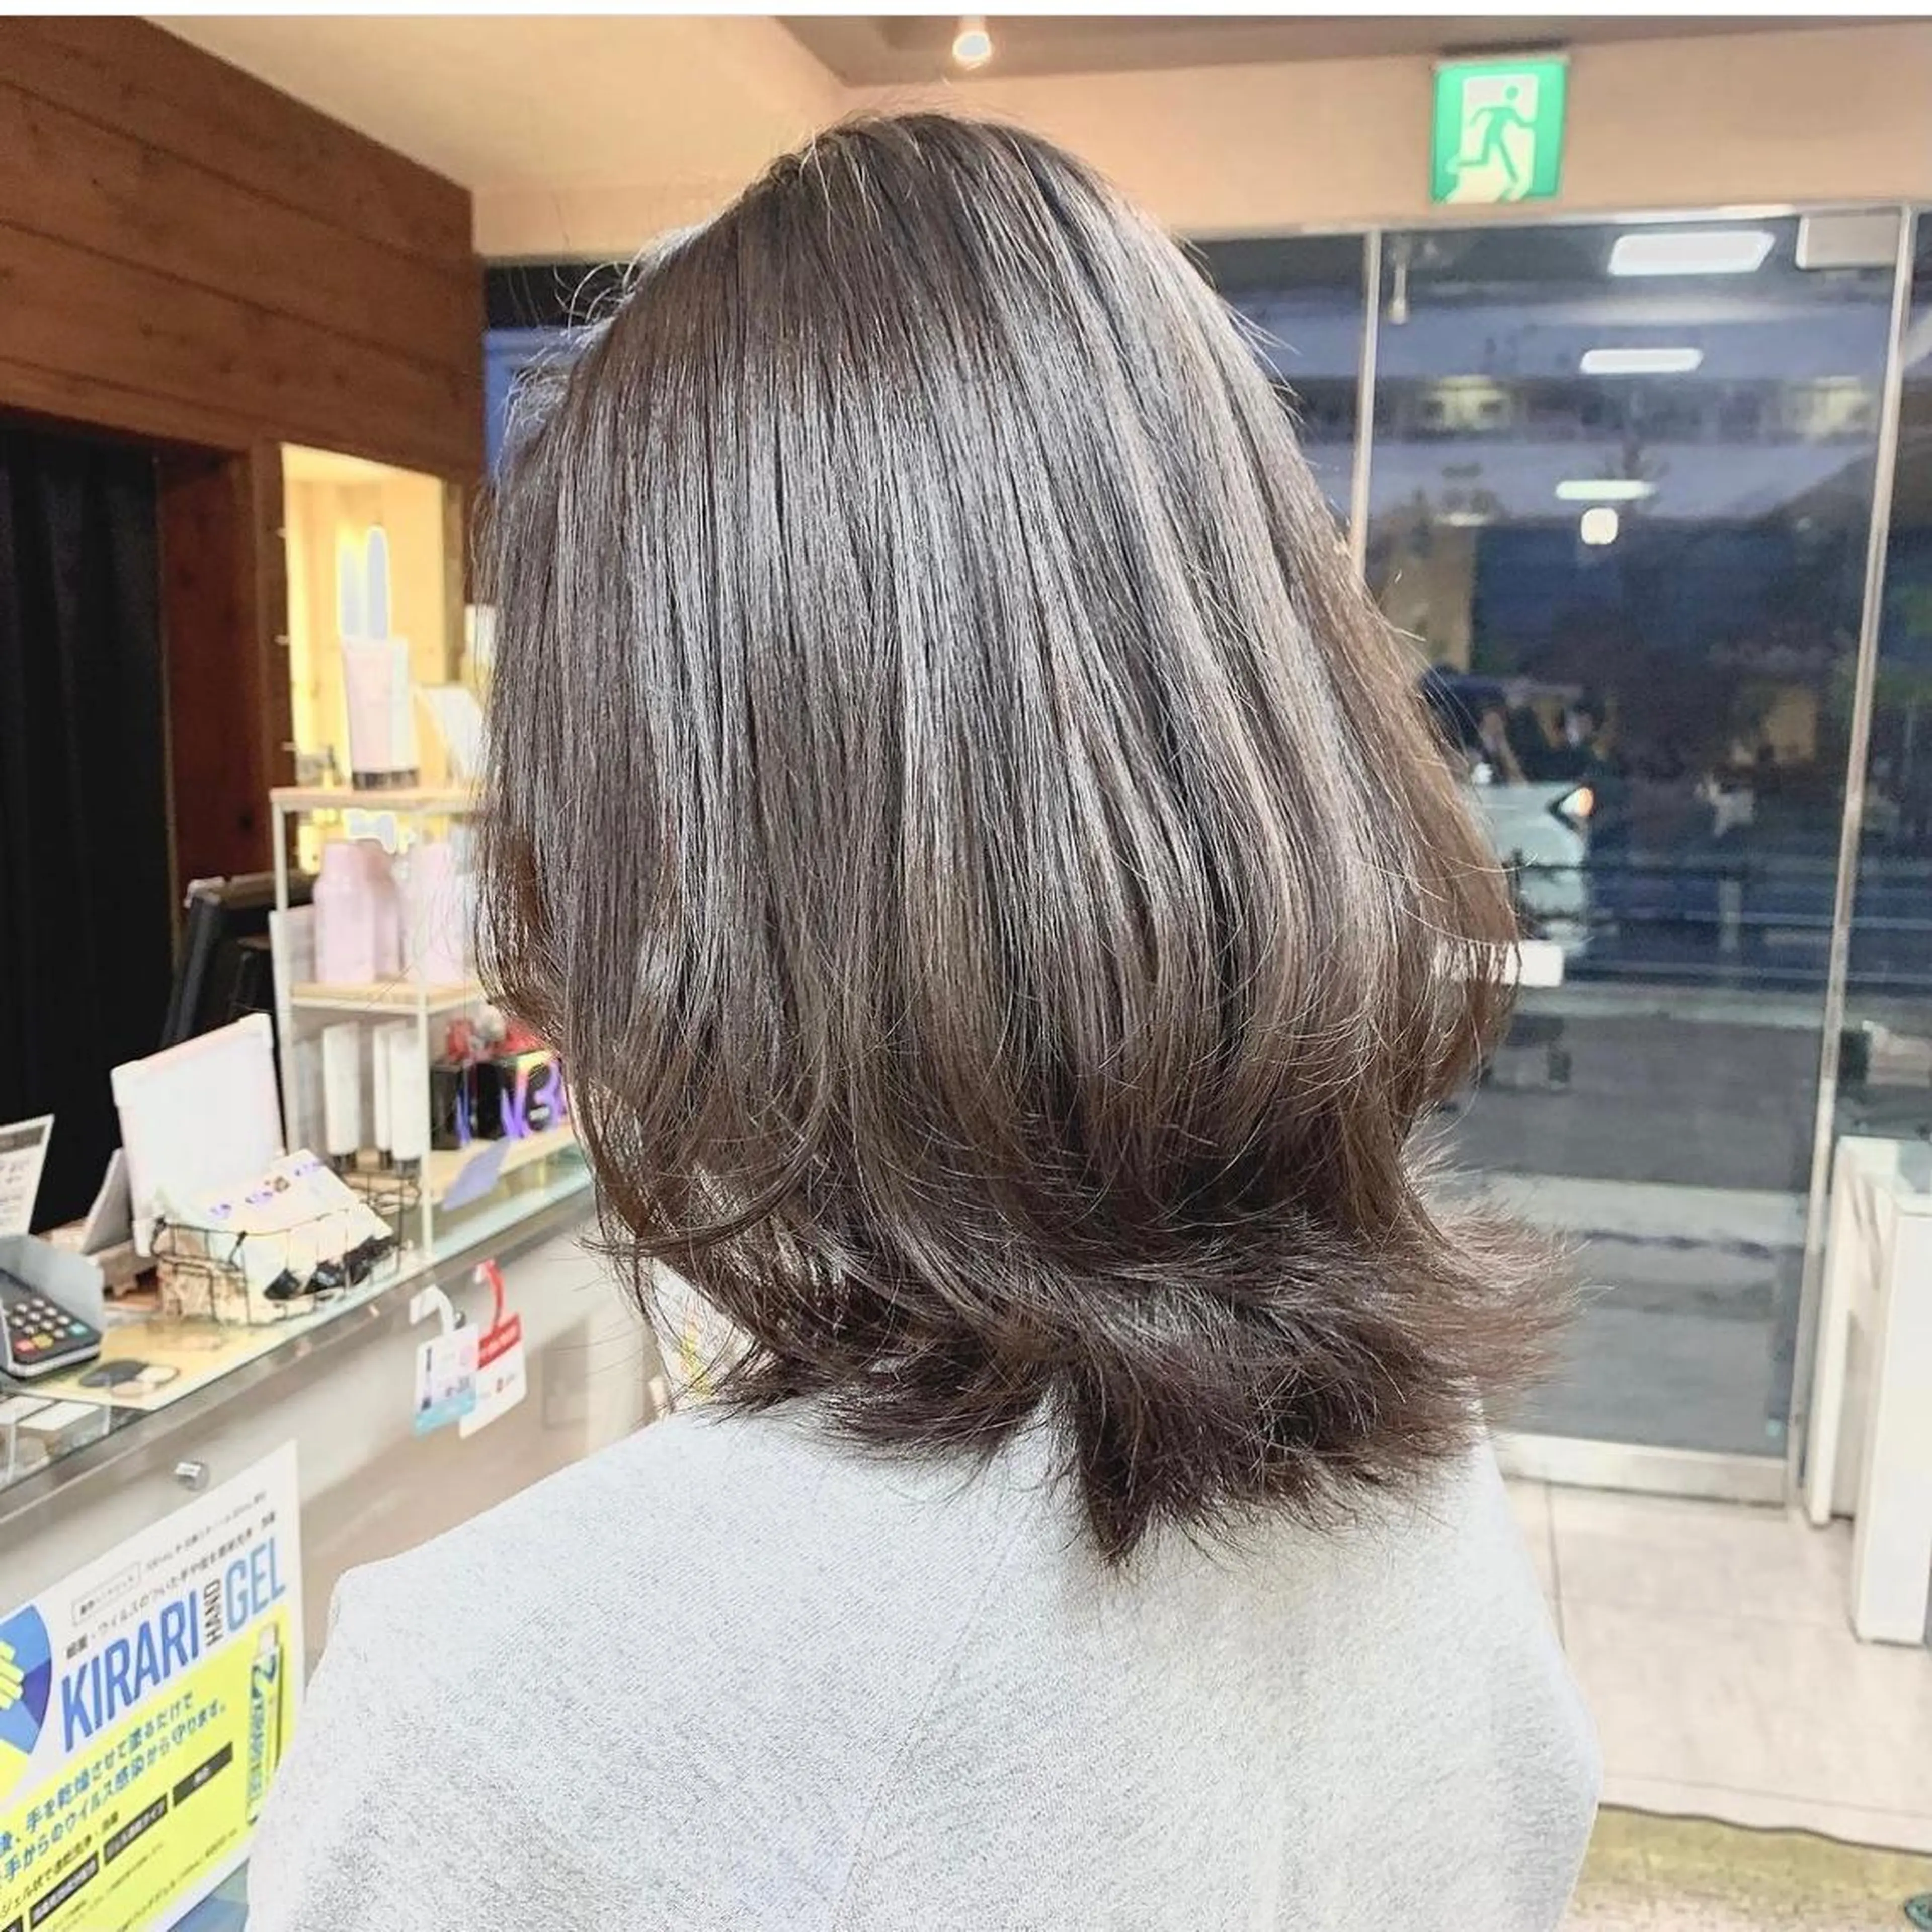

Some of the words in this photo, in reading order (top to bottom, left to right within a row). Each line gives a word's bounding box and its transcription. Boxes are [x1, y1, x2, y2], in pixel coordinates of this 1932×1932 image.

[61, 1590, 199, 1753] KIRARI
[204, 1579, 224, 1647] HAND
[225, 1536, 286, 1632] GEL
